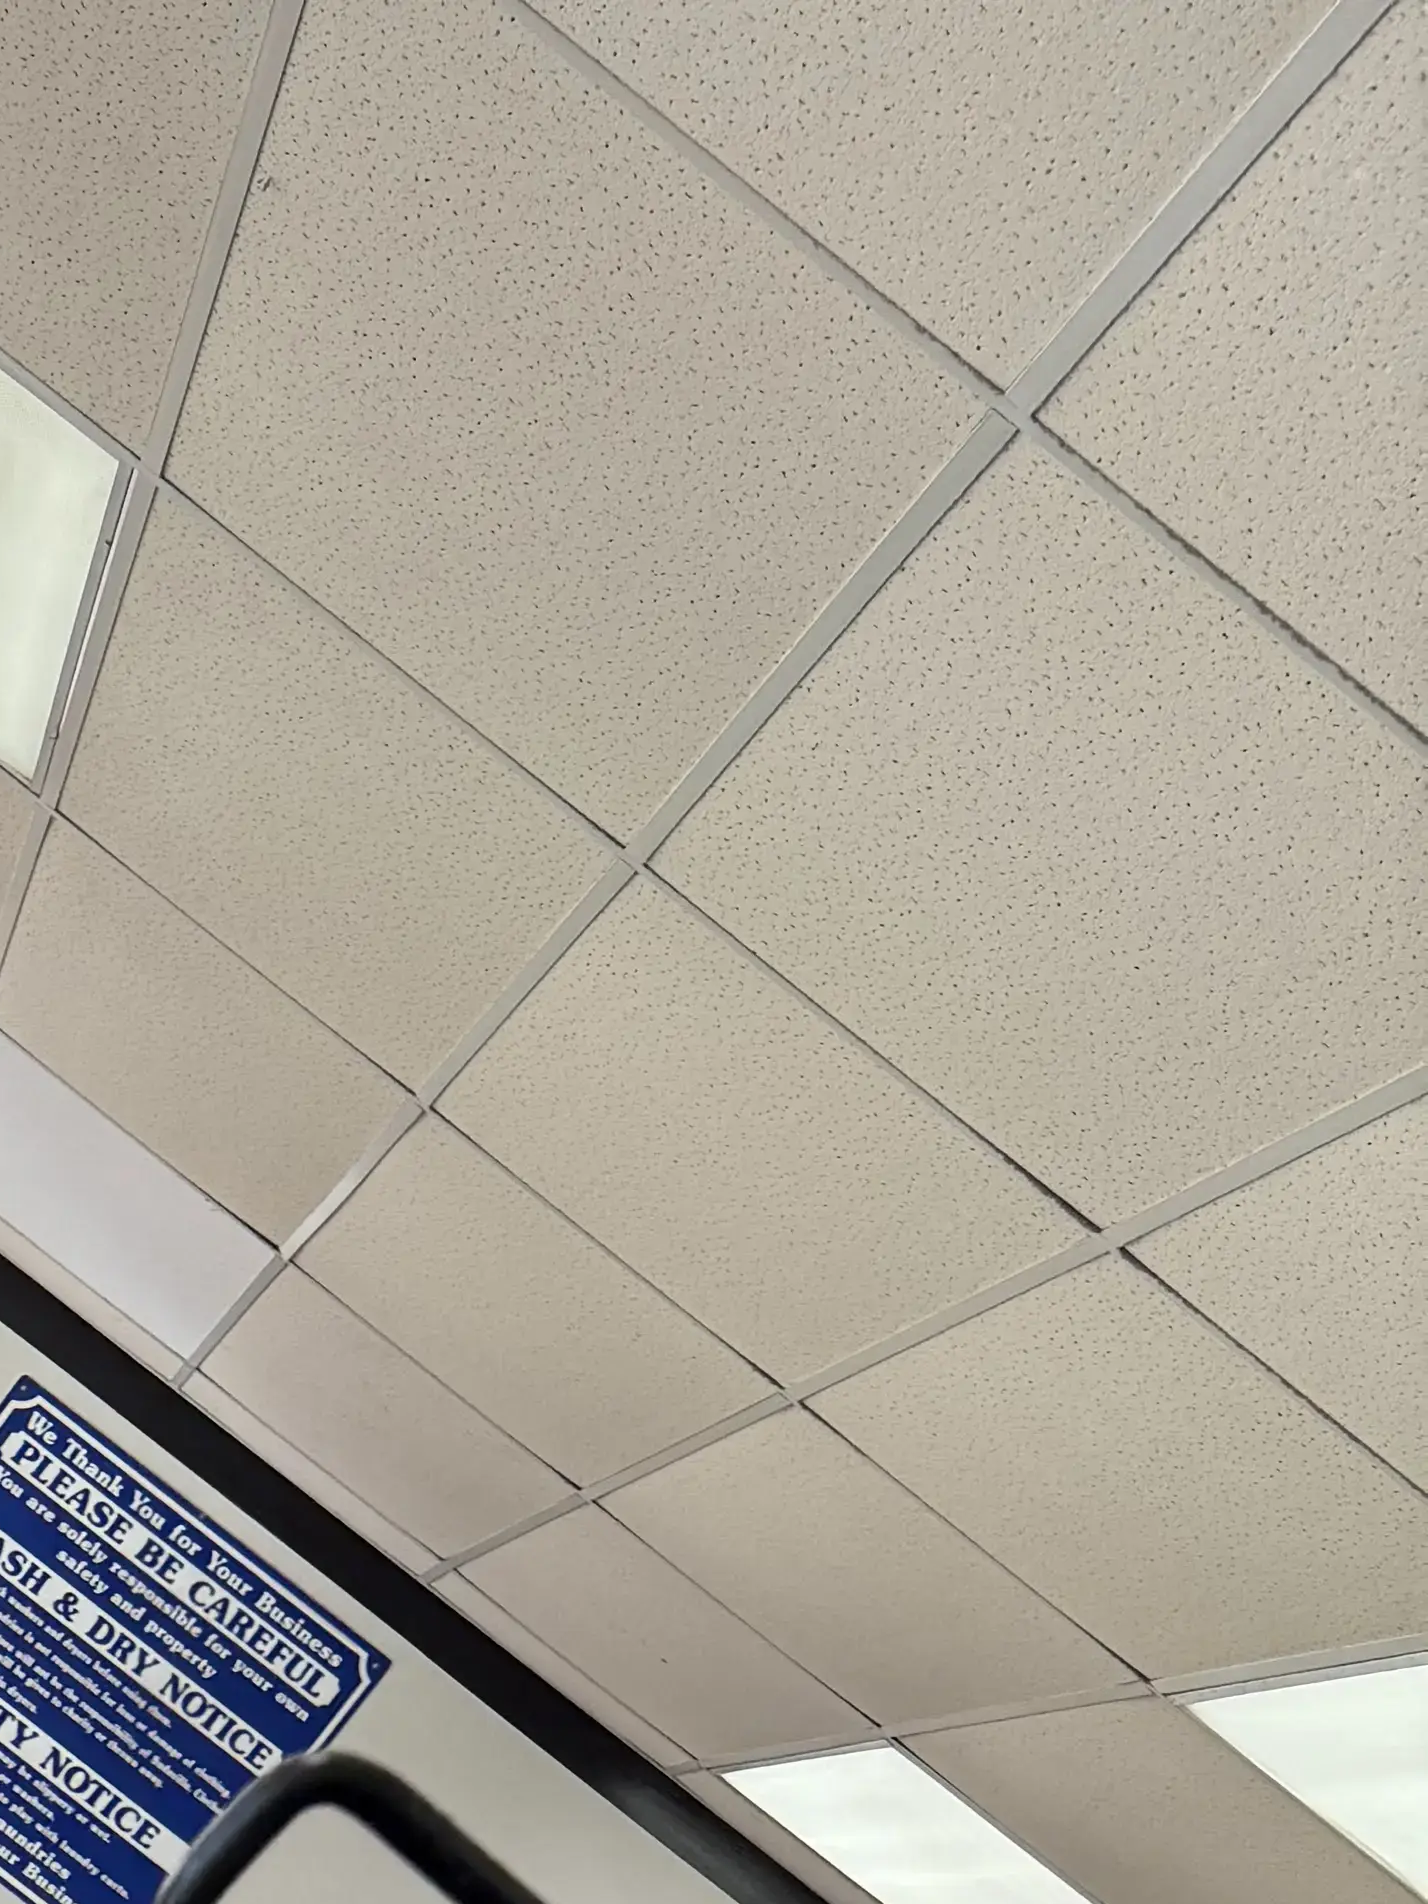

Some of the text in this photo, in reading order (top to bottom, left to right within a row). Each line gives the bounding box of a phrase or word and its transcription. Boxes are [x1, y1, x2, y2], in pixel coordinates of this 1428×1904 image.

[7, 1438, 331, 1700] PLEASE BE CAREFUL
[25, 1497, 55, 1522] are
[56, 1521, 107, 1563] solely
[108, 1561, 202, 1637] responsible
[203, 1633, 231, 1658] for
[231, 1659, 273, 1691] your
[274, 1692, 309, 1721] own
[27, 1410, 342, 1667] We Thank You for Your Business
[55, 1550, 216, 1678] safety and property
[50, 1589, 85, 1625] &
[83, 1615, 159, 1683] DRY
[156, 1672, 275, 1773] NOTICE
[37, 1746, 163, 1851] NOTICE
